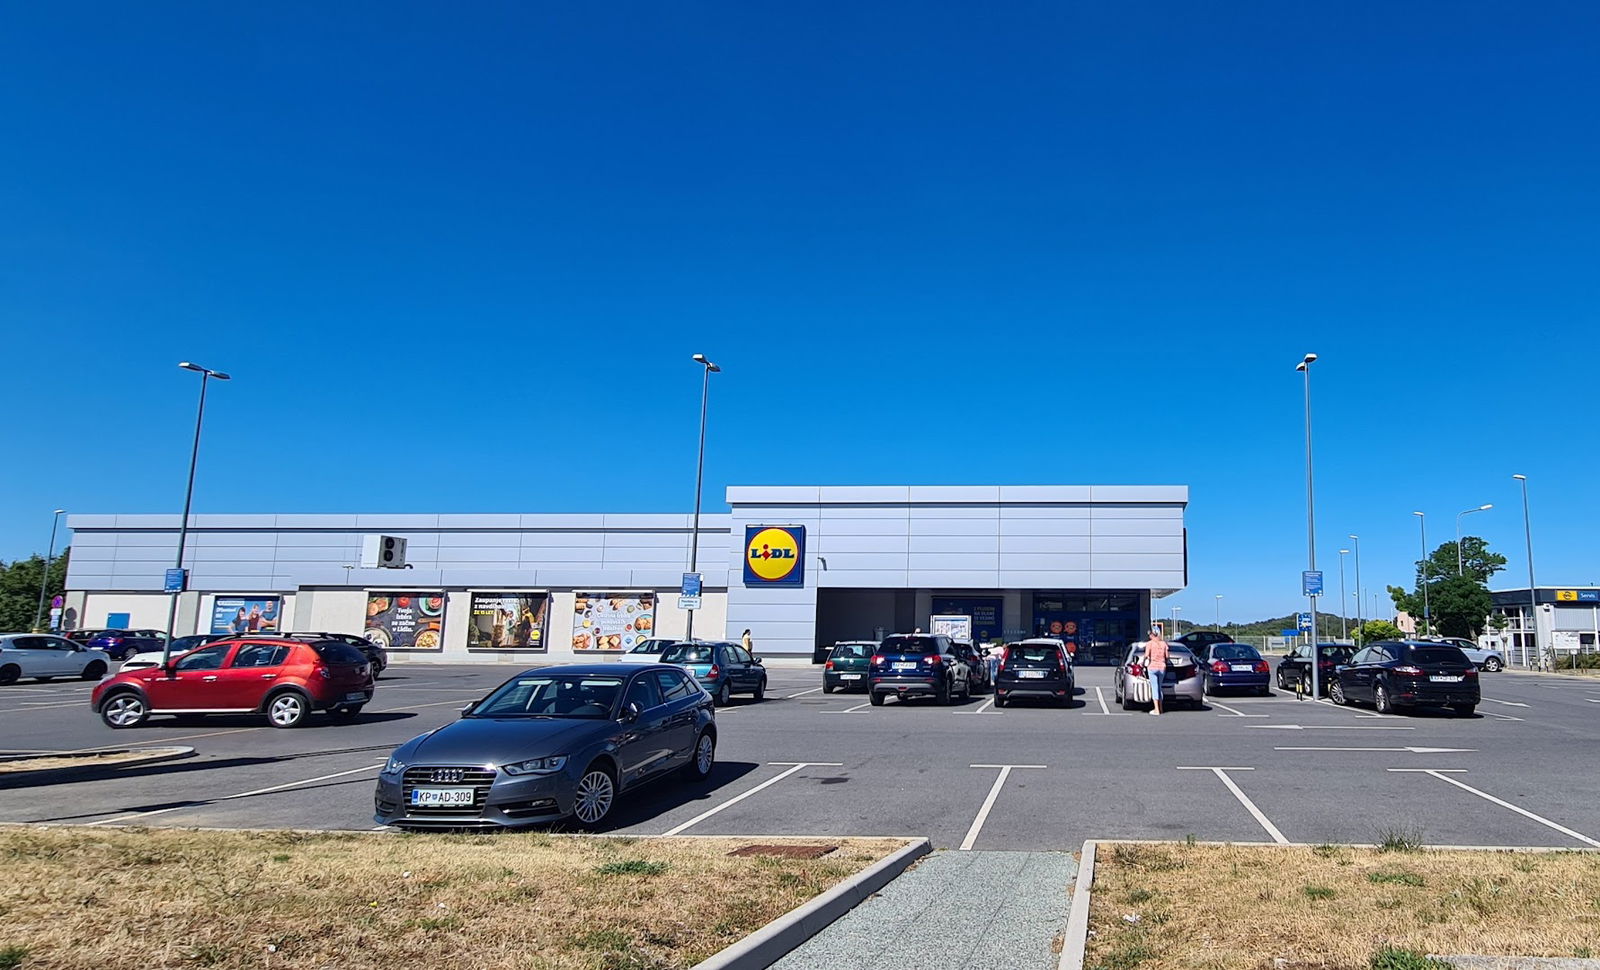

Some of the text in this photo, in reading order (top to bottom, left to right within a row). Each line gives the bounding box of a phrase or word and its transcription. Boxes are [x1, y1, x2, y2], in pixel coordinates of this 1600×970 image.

[751, 544, 794, 561] LIDL
[419, 792, 471, 802] KP AD-309
